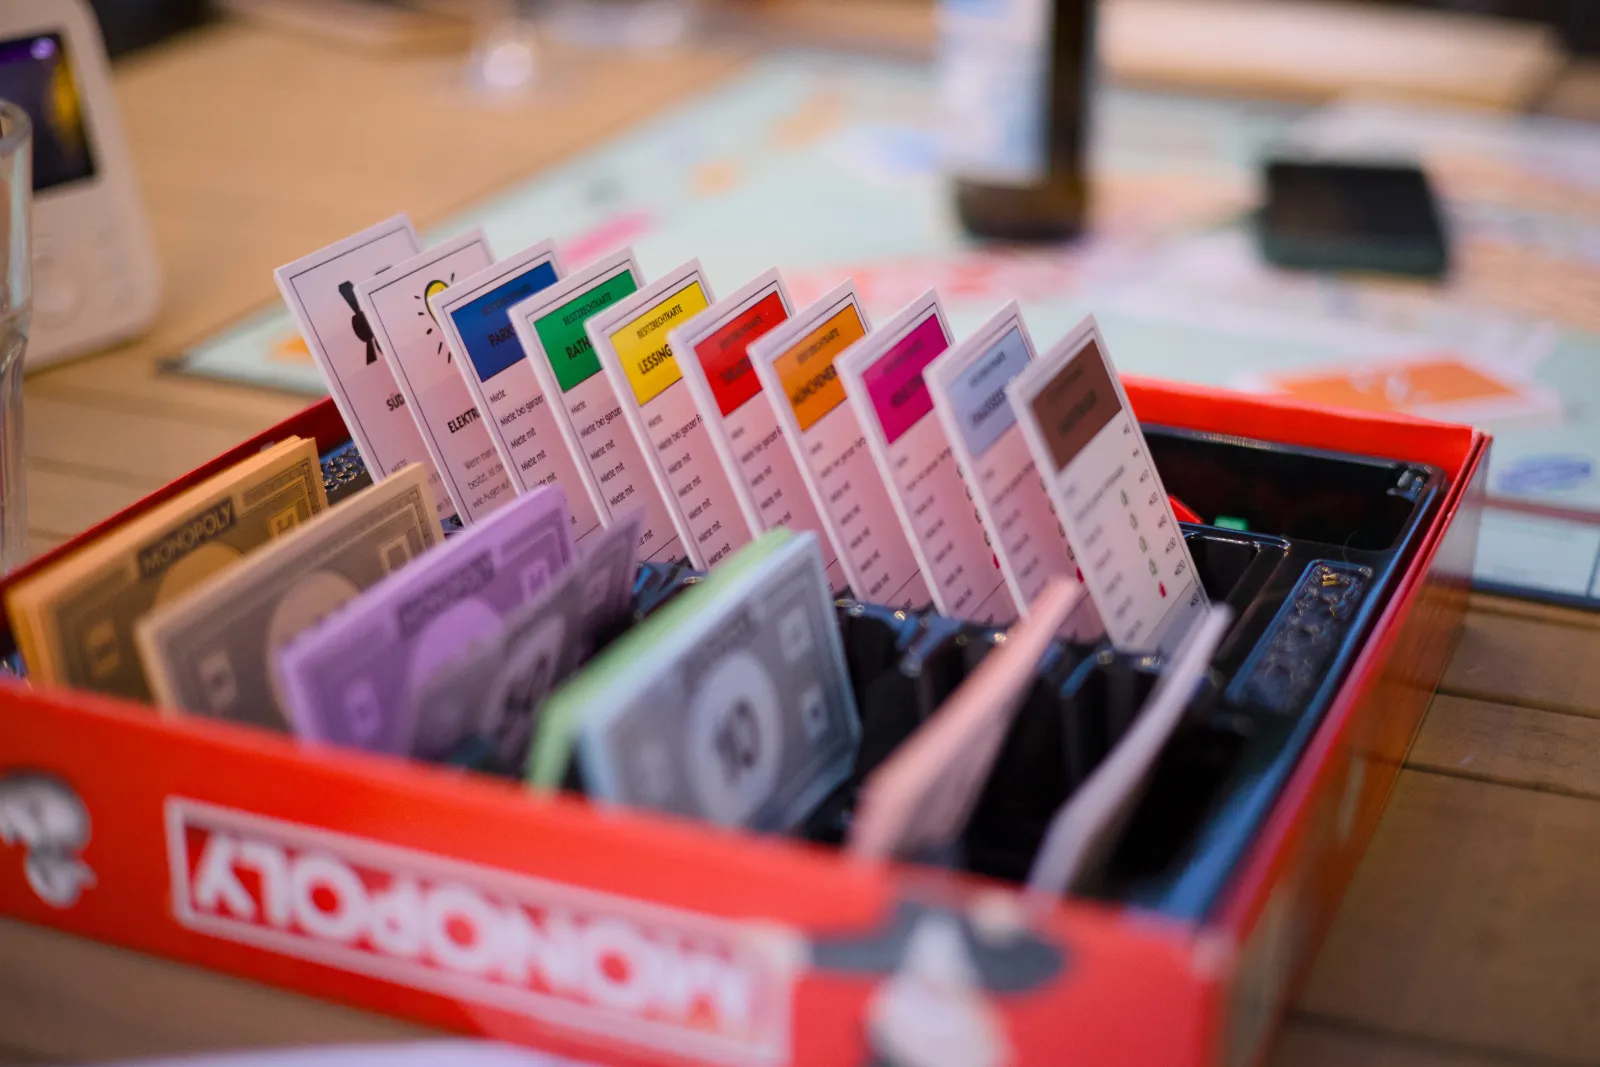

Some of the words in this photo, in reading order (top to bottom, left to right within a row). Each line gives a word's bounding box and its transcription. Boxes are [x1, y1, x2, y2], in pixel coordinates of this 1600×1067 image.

[562, 291, 613, 326] BESITZRECHTKARTE
[635, 303, 683, 340] BESITZRECHTKARTE
[637, 343, 673, 376] LESSING
[490, 389, 507, 404] Miete
[500, 411, 517, 426] Miete
[515, 405, 526, 416] bei
[525, 395, 544, 412] ganzer
[510, 433, 526, 449] Miete
[526, 427, 537, 438] mit
[580, 423, 597, 438] Miete
[595, 416, 606, 427] bei
[520, 456, 537, 472] Miete
[536, 449, 547, 460] mit
[590, 445, 606, 461] Miete
[605, 439, 616, 451] mit
[546, 472, 557, 482] mit
[600, 468, 616, 484] Miete
[615, 461, 625, 473] mit
[610, 491, 626, 507] Miete
[625, 484, 635, 495] mit
[678, 482, 694, 498] Miete
[692, 475, 702, 486] mit
[688, 505, 704, 520] Miete
[702, 497, 712, 508] mit
[141, 501, 234, 572] MONOPOLY
[698, 527, 714, 544] Miete
[712, 520, 722, 531] mit
[708, 550, 724, 566] Miete
[722, 542, 732, 554] mit
[197, 834, 750, 1034] MONOPOLY
